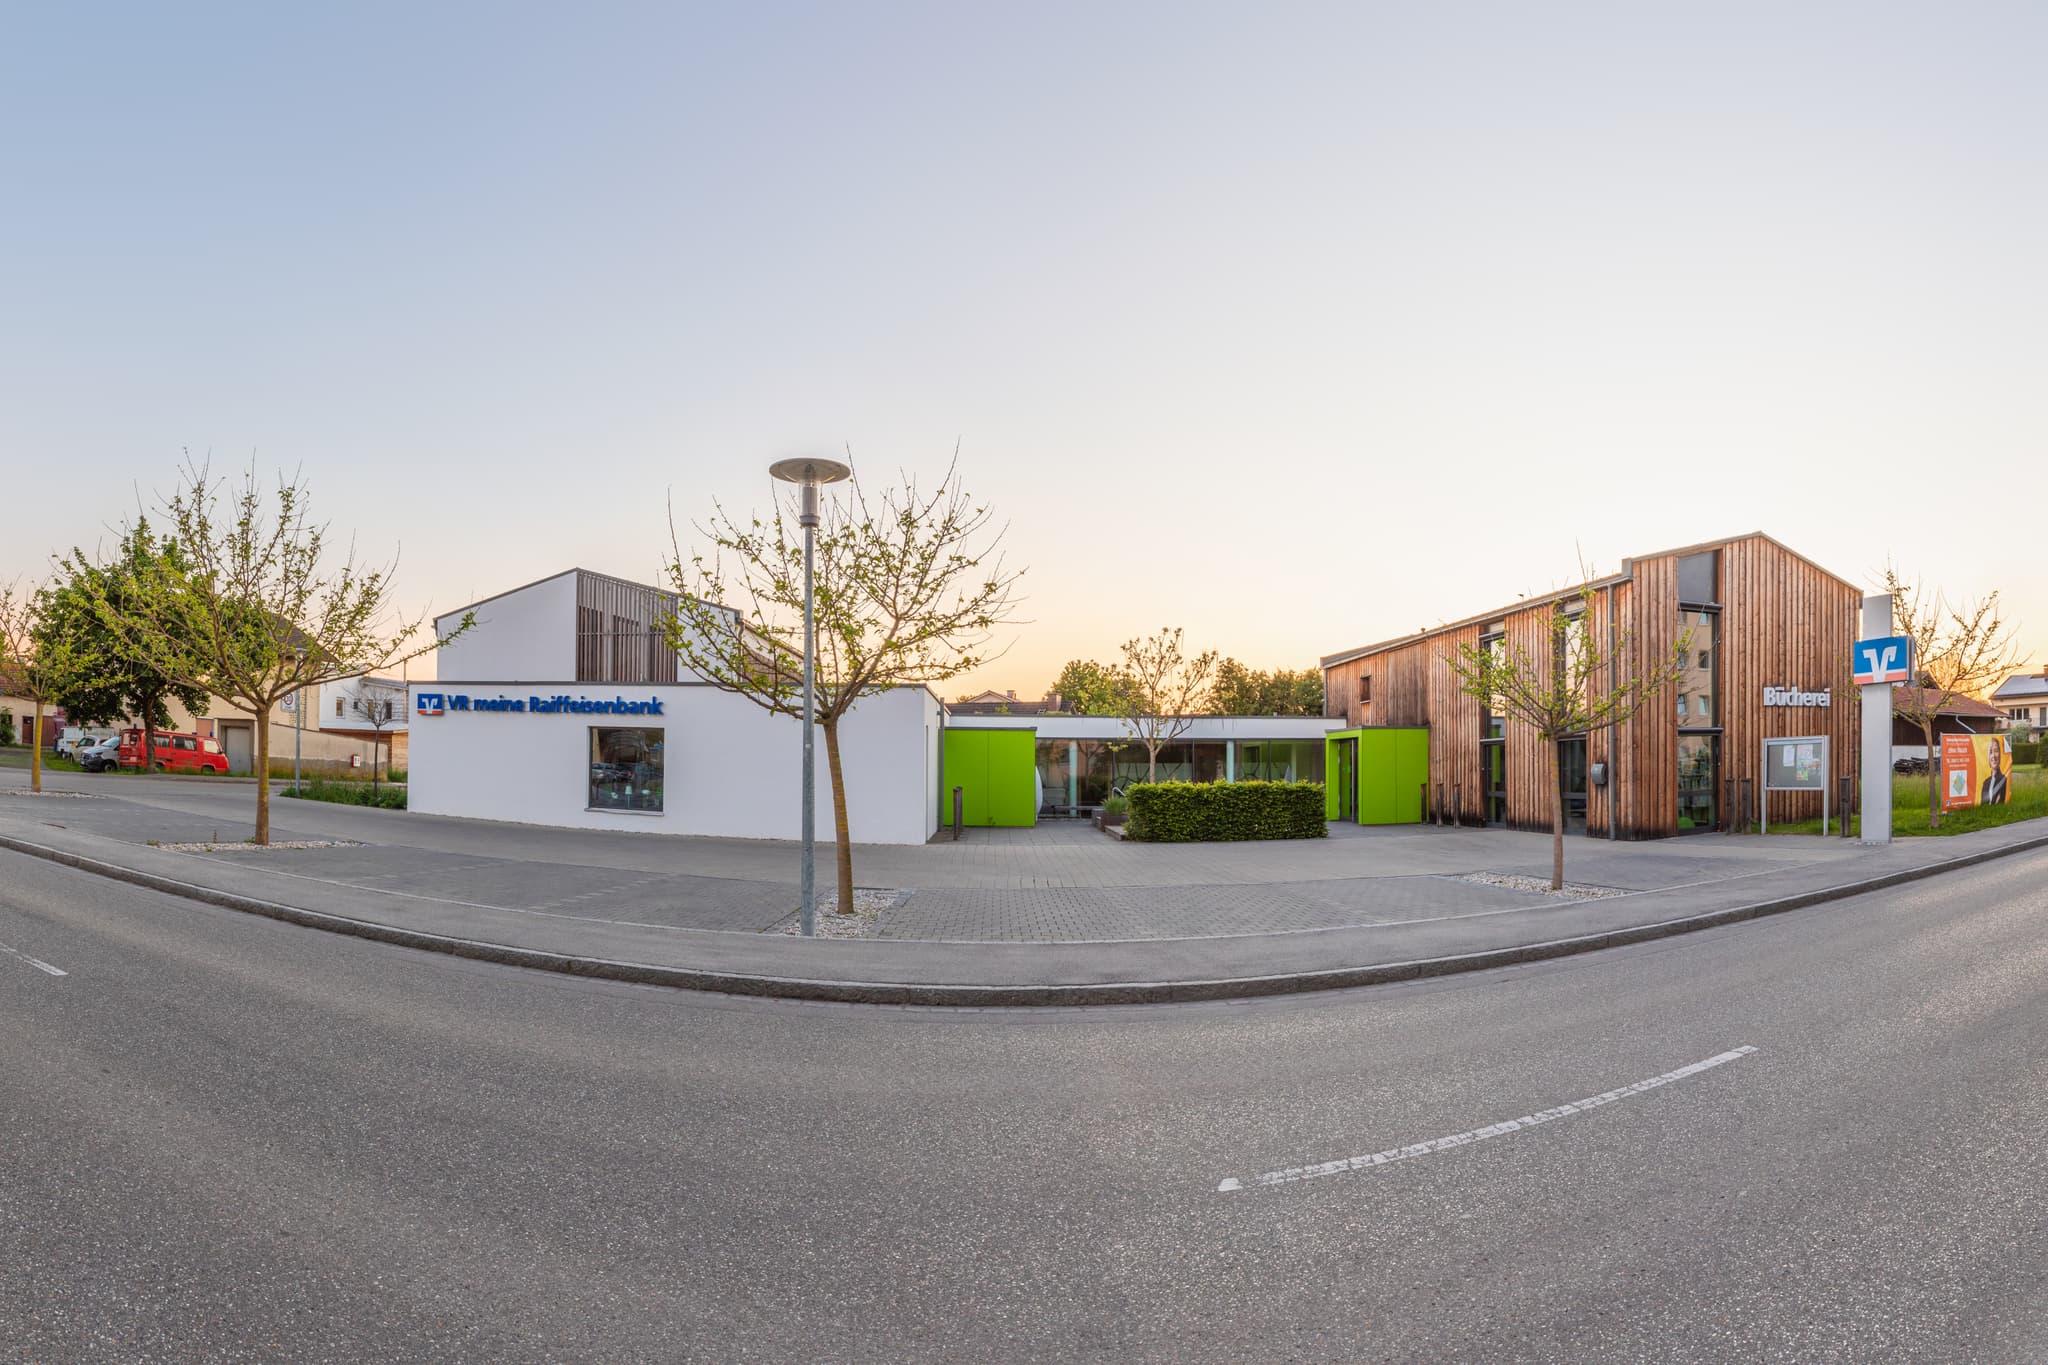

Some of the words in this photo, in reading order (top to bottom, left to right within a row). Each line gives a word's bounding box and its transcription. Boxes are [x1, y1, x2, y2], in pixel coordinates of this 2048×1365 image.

[447, 695, 469, 711] VR
[474, 695, 523, 712] meine
[529, 696, 664, 715] Raiffeisenbank
[1763, 686, 1831, 706] Bücherei
